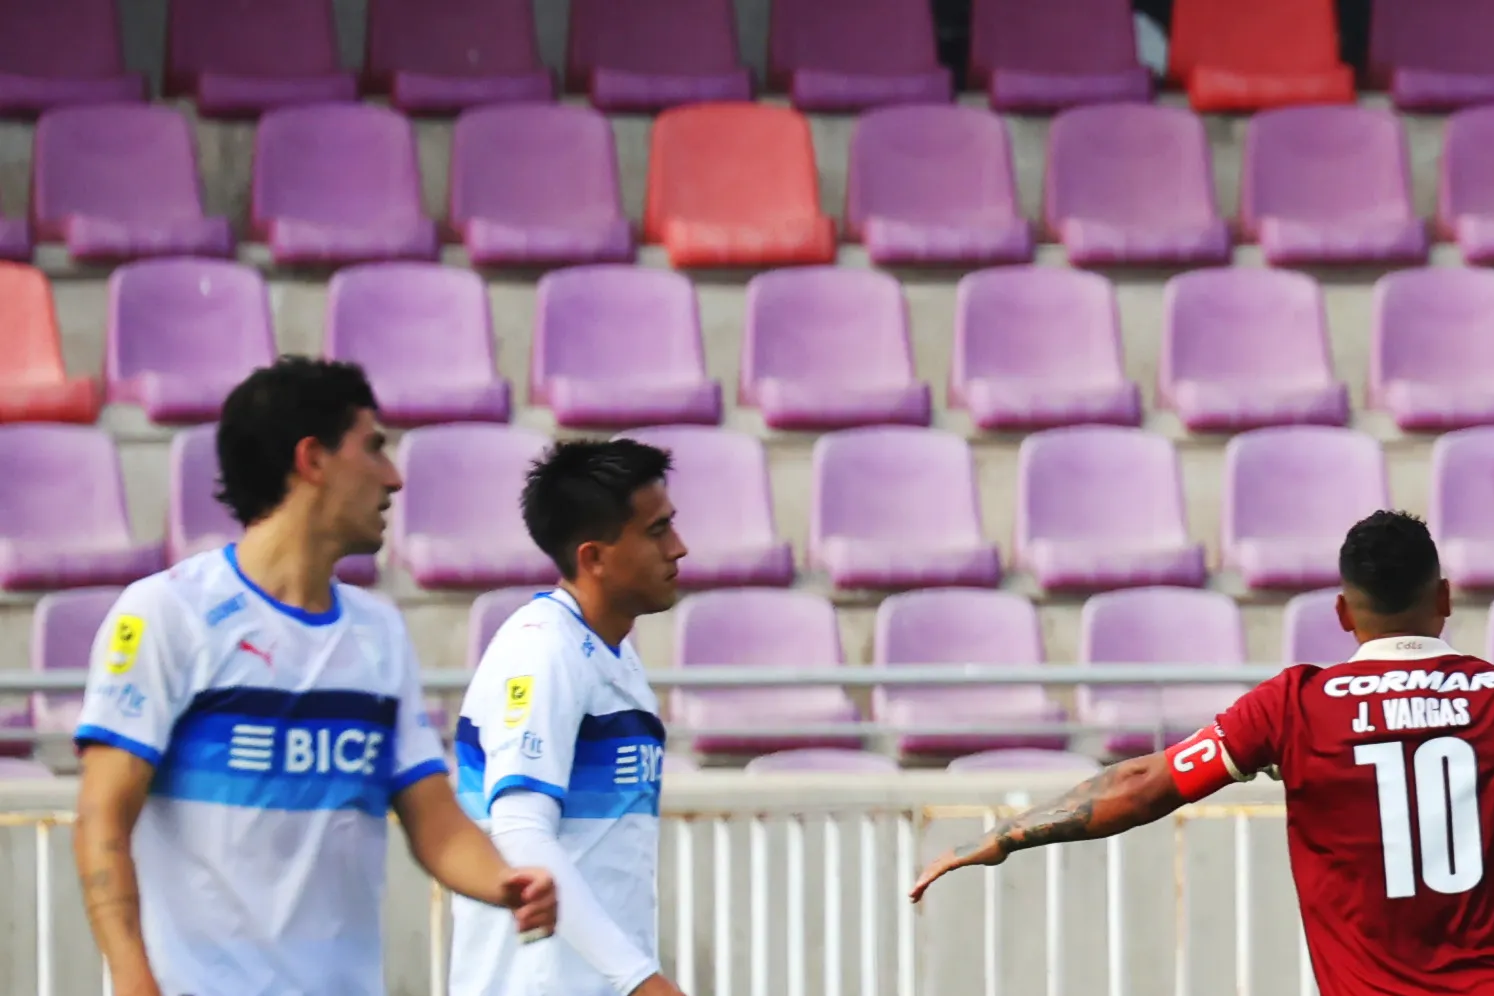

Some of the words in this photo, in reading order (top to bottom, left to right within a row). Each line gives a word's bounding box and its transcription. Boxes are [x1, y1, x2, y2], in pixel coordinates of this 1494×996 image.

[1352, 701, 1376, 734] J.
[1382, 696, 1472, 731] VARGAS
[1353, 736, 1484, 899] 10
